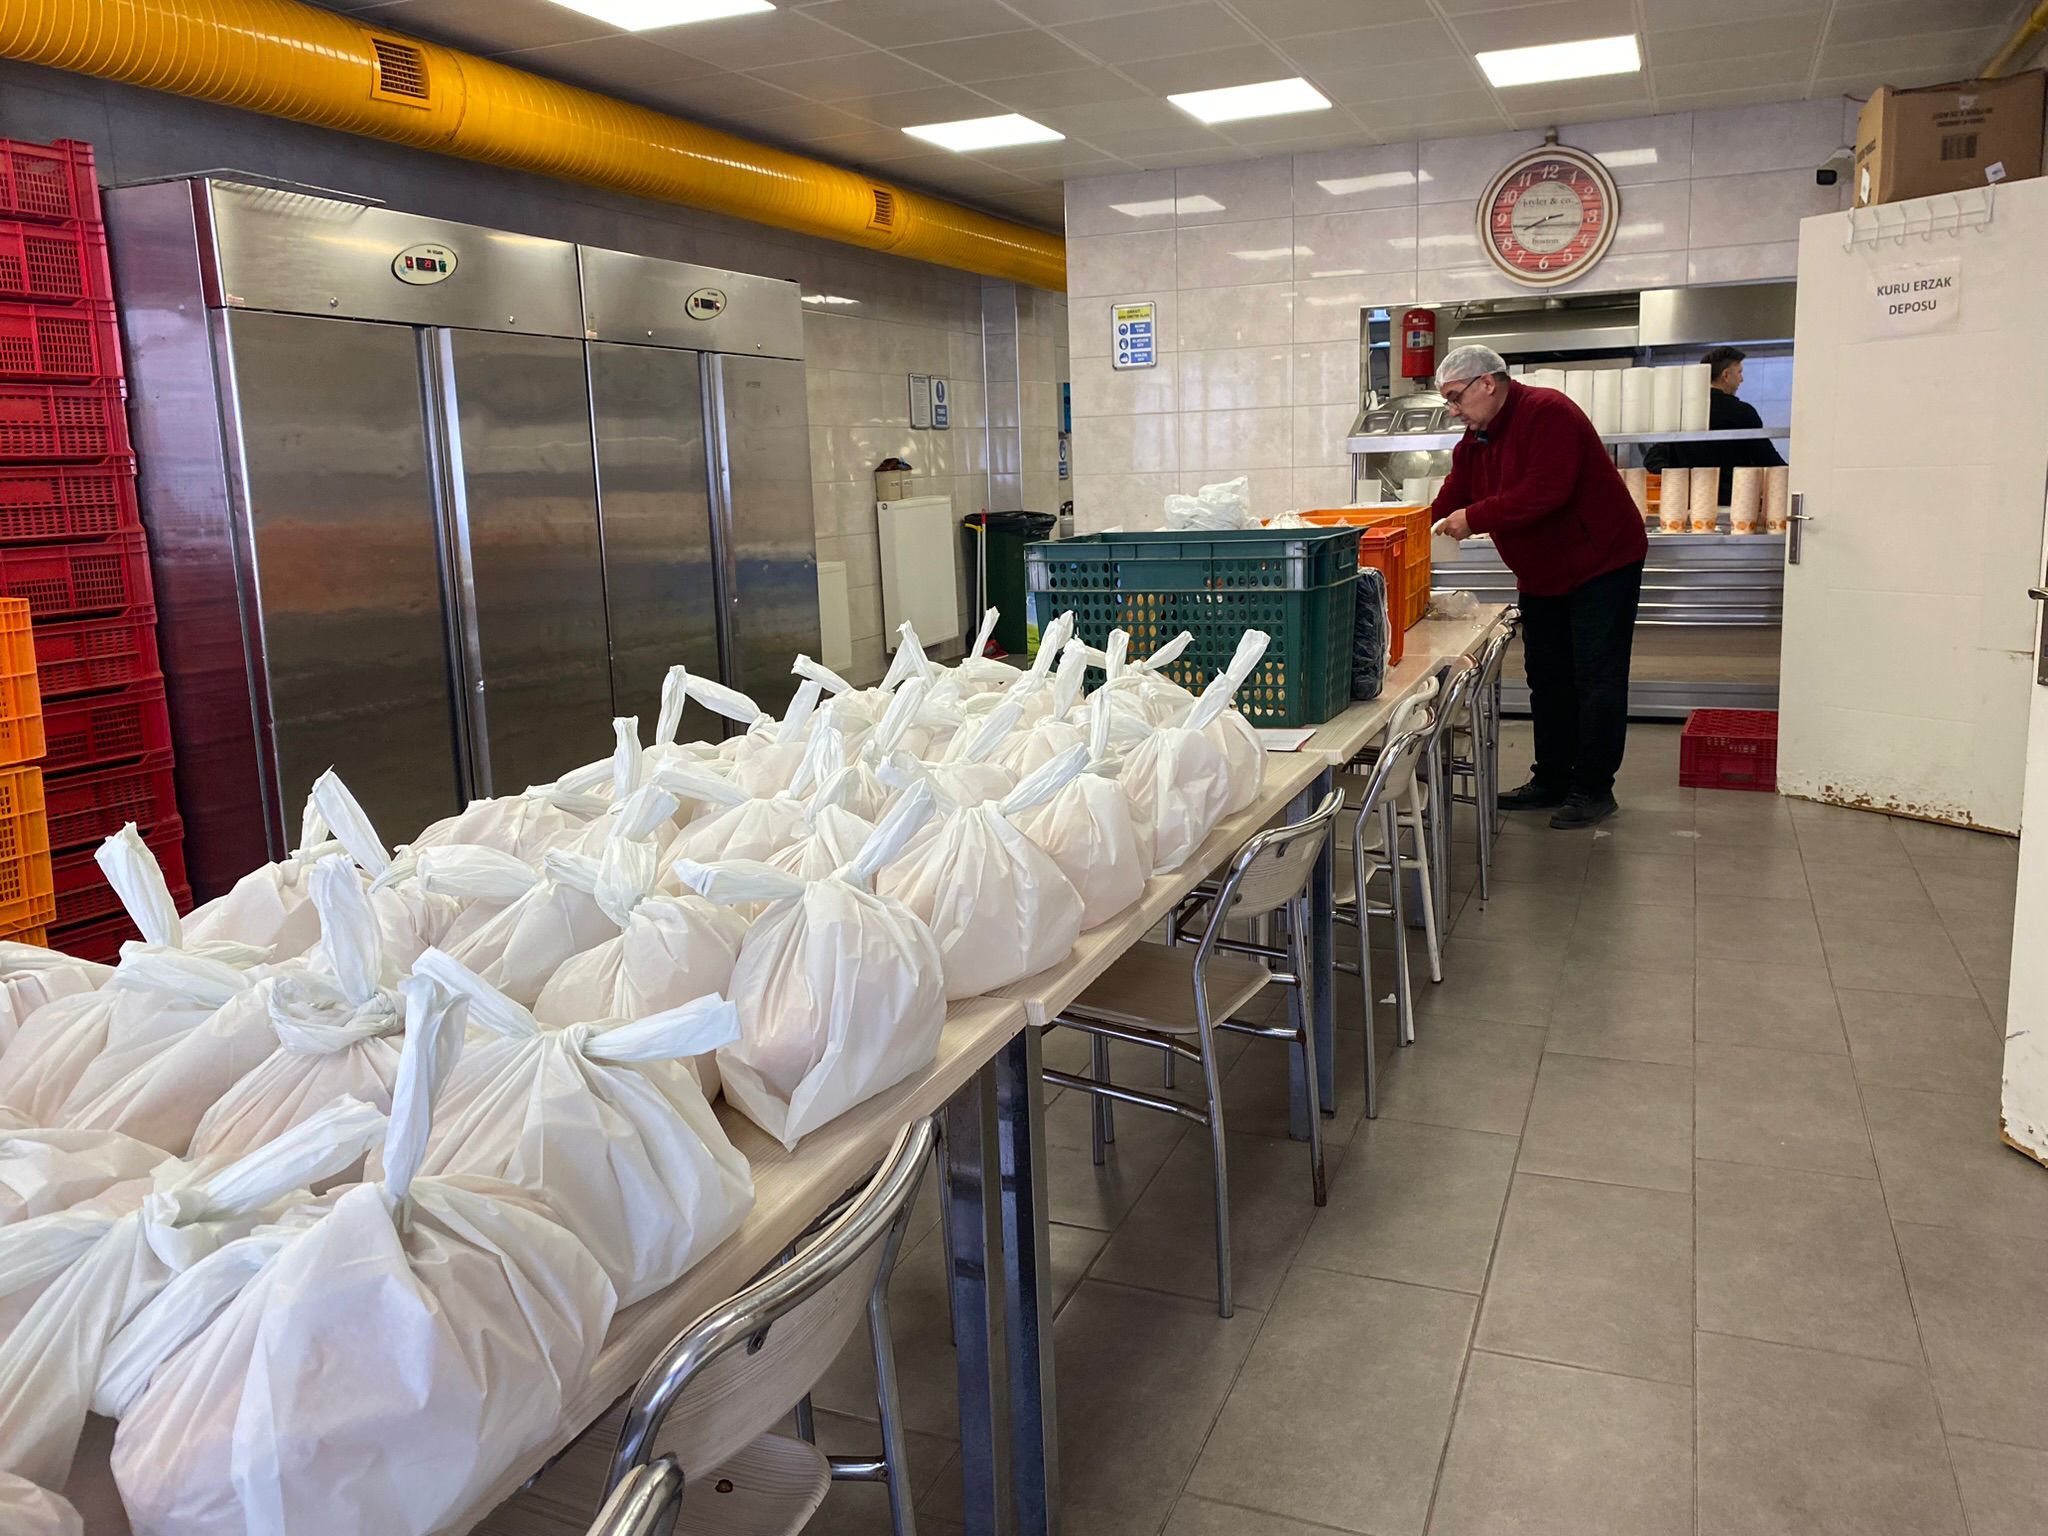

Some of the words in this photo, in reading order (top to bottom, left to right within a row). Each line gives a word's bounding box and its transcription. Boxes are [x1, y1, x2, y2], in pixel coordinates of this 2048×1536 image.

[1542, 165, 1559, 179] 12
[1570, 171, 1577, 184] 1
[1519, 174, 1532, 187] 11
[1503, 190, 1518, 203] 10
[1584, 187, 1594, 199] 2
[1497, 213, 1507, 226] 9
[1587, 209, 1598, 223] 3
[1502, 237, 1513, 250] 8
[1580, 234, 1589, 247] 4
[1517, 250, 1526, 263] 7
[1562, 249, 1573, 262] 5
[1539, 256, 1549, 270] 6
[1877, 283, 1910, 296] KURU
[1913, 277, 1952, 291] ERZAK
[1889, 300, 1937, 315] DEPOSU
